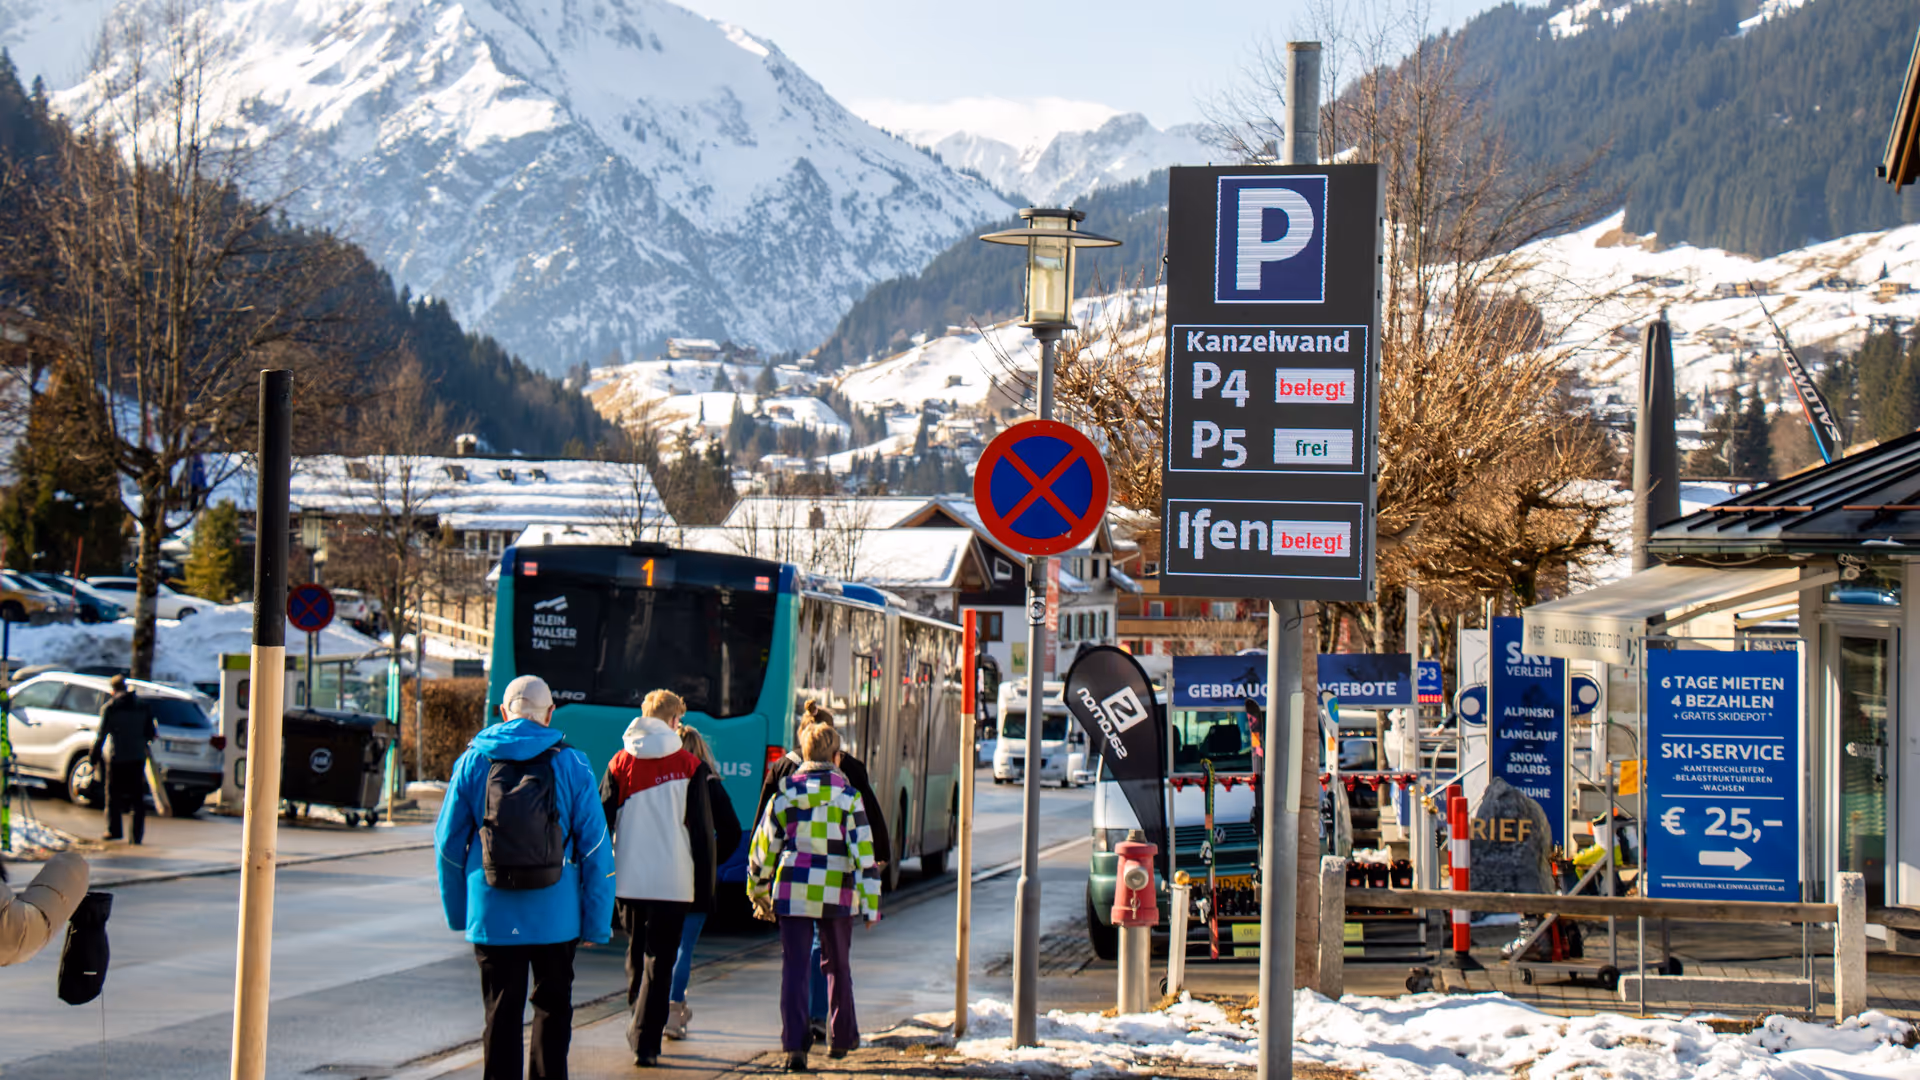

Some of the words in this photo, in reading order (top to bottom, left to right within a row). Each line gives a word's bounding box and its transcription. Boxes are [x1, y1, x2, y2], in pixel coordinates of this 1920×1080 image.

[1236, 188, 1314, 290] P
[1187, 330, 1350, 353] Kanzelwand
[1192, 361, 1250, 408] P4
[1279, 378, 1346, 401] belegt
[1192, 420, 1248, 468] P5
[1295, 440, 1328, 456] frei
[1178, 508, 1269, 560] Ifen
[1281, 532, 1343, 554] belegt
[641, 558, 654, 587] 1
[533, 614, 567, 626] KLEIN
[532, 626, 577, 639] WALSER
[531, 638, 551, 650] TAL
[1418, 667, 1438, 681] P3
[1505, 665, 1553, 678] VERLEIH
[1661, 676, 1671, 689] 6
[1674, 675, 1718, 690] TAGE
[1722, 676, 1784, 690] MIETEN
[1188, 683, 1268, 698] GEBRAUC
[1671, 694, 1681, 707] 4
[1686, 694, 1774, 709] BEZAHLEN
[1504, 706, 1555, 719] ALPINSKI
[1681, 711, 1716, 721] GRATIS
[1718, 712, 1766, 721] SKIDEPOT
[1500, 728, 1559, 742] LANGLAUF
[1509, 752, 1548, 763] SNOW-
[1661, 743, 1785, 761] SKI-SERVICE
[1506, 763, 1552, 775] BOARDS
[1680, 765, 1765, 774] -KANTENSCHLEIFEN
[1672, 774, 1773, 783] -BELAGSTRUKTURIEREN
[1470, 817, 1533, 842] RIEF
[1660, 806, 1686, 836] €
[1704, 806, 1783, 843] 25,-
